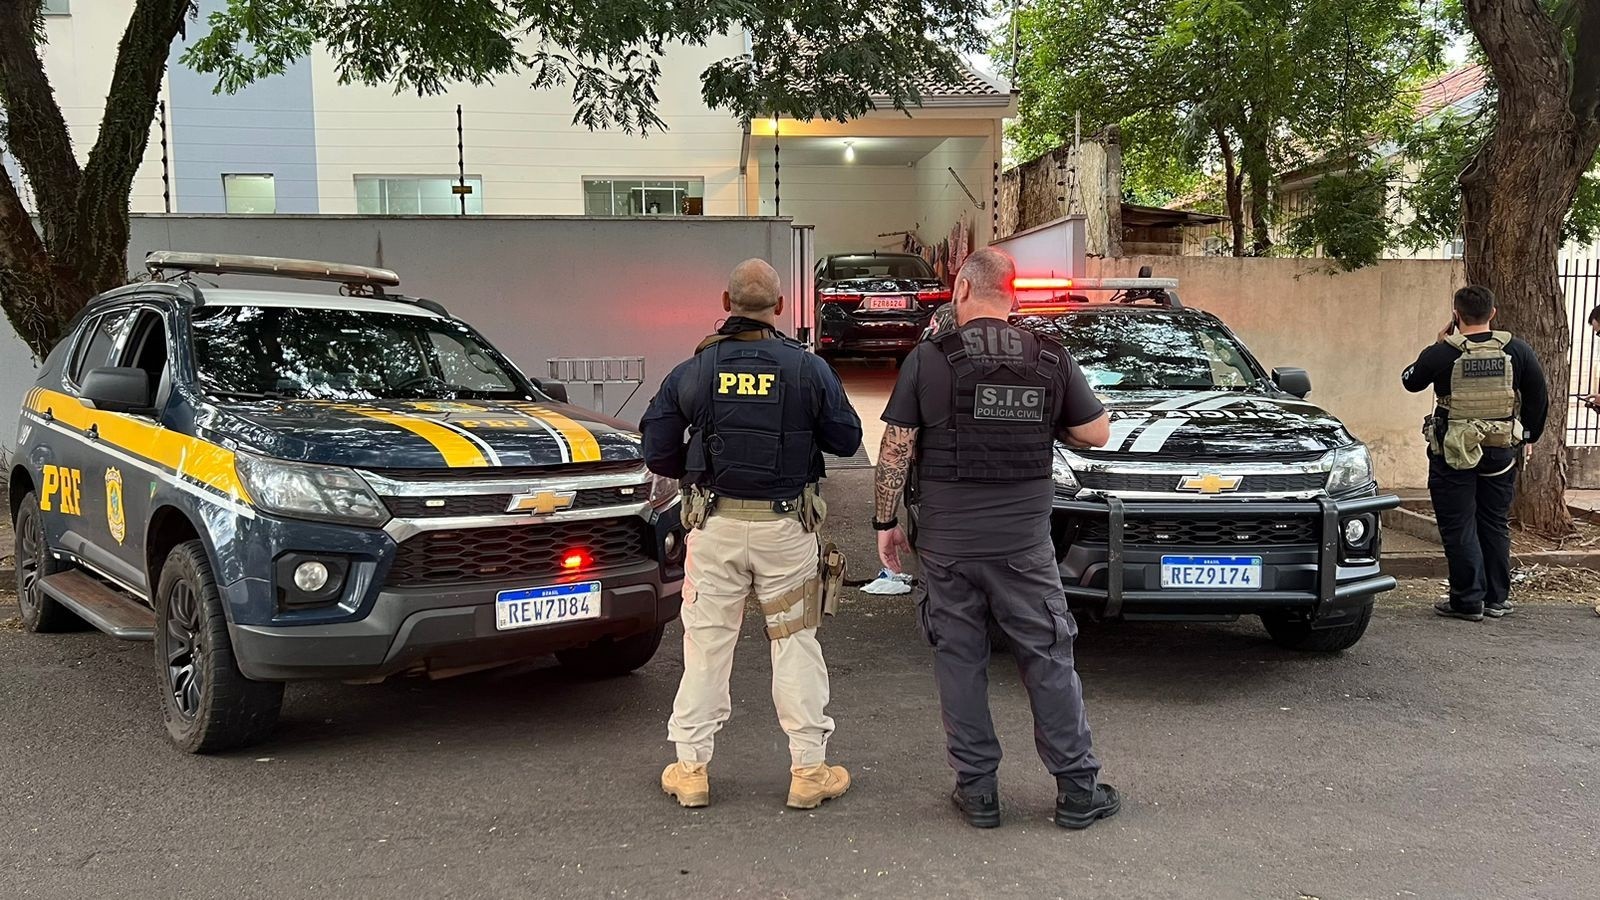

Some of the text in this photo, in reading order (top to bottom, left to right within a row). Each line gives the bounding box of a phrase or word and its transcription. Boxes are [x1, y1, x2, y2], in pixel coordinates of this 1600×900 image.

[961, 326, 1023, 355] SIG
[1464, 359, 1504, 371] DENARC
[718, 372, 775, 395] PRF
[981, 387, 1039, 408] S.I.G
[976, 406, 1040, 418] POLÍCIA CIVIL
[455, 419, 529, 428] PRF
[40, 464, 81, 516] PRF
[1171, 567, 1250, 585] REZ9I74
[508, 595, 590, 624] REW7D84
